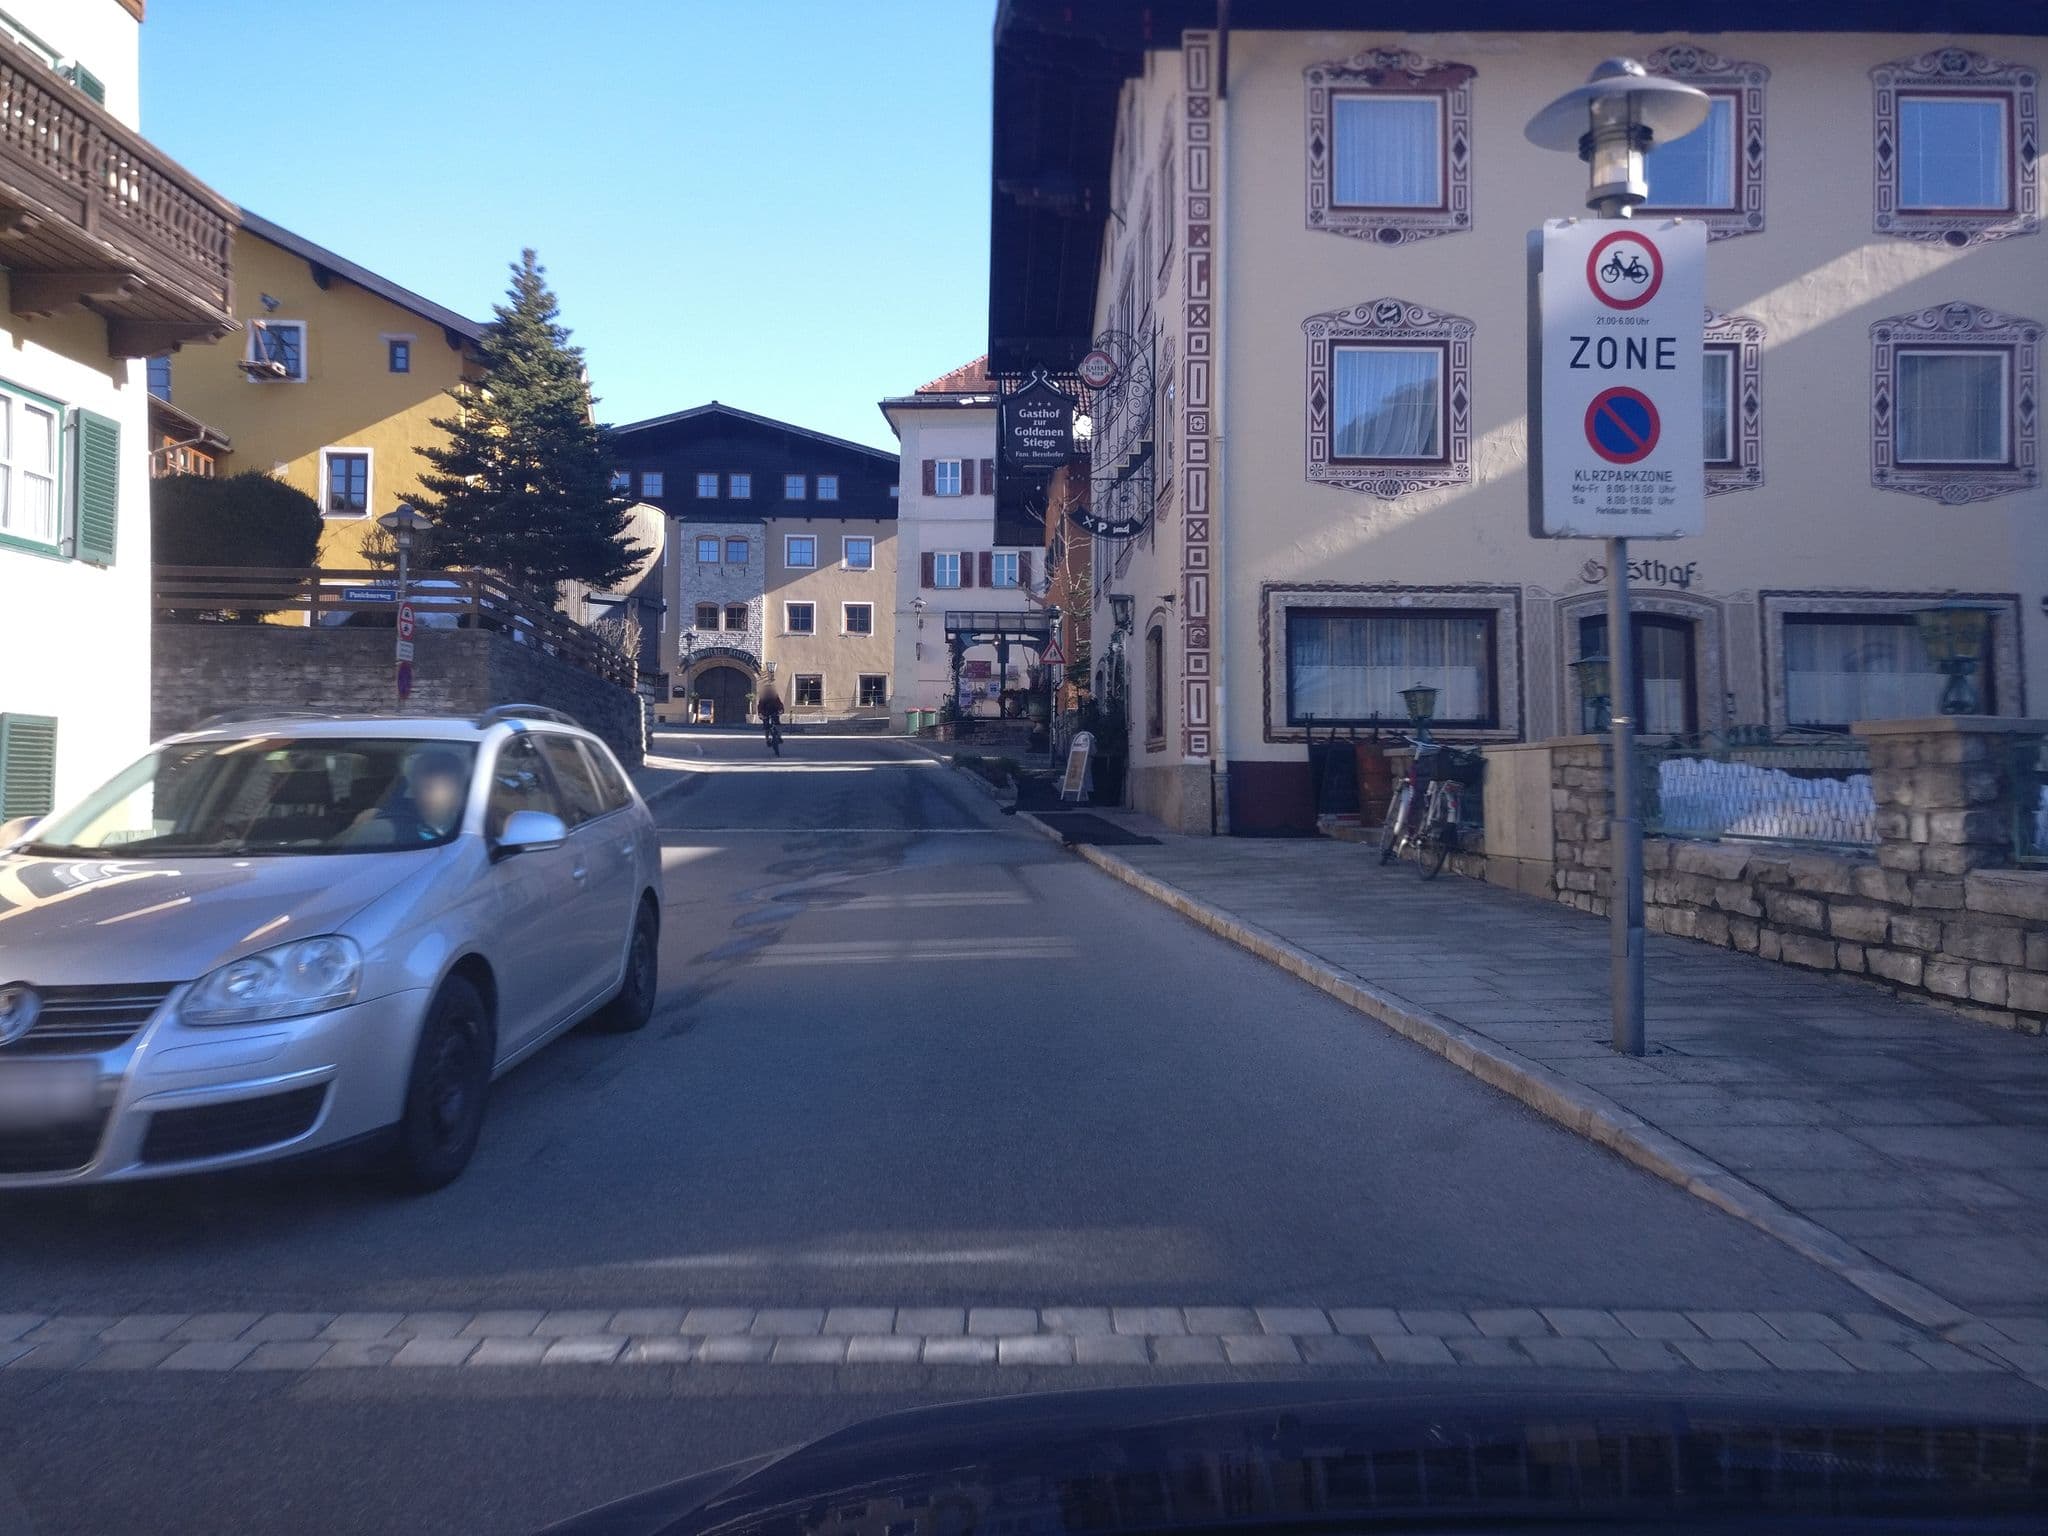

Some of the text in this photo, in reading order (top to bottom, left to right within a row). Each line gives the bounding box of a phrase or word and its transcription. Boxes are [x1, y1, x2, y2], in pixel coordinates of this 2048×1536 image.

[1635, 316, 1650, 326] Uhr
[1569, 336, 1677, 370] ZONE
[1085, 364, 1110, 373] KAISER
[1018, 408, 1060, 418] Gasthof
[1014, 426, 1064, 437] Goldenen
[1023, 437, 1056, 449] Stiege
[1572, 484, 1599, 493] Mo-Fr
[1658, 484, 1677, 493] Uhr
[1572, 495, 1585, 504] Sa
[1658, 496, 1675, 505] Uhr
[1097, 522, 1108, 533] P
[1580, 558, 1697, 588] Gsthof
